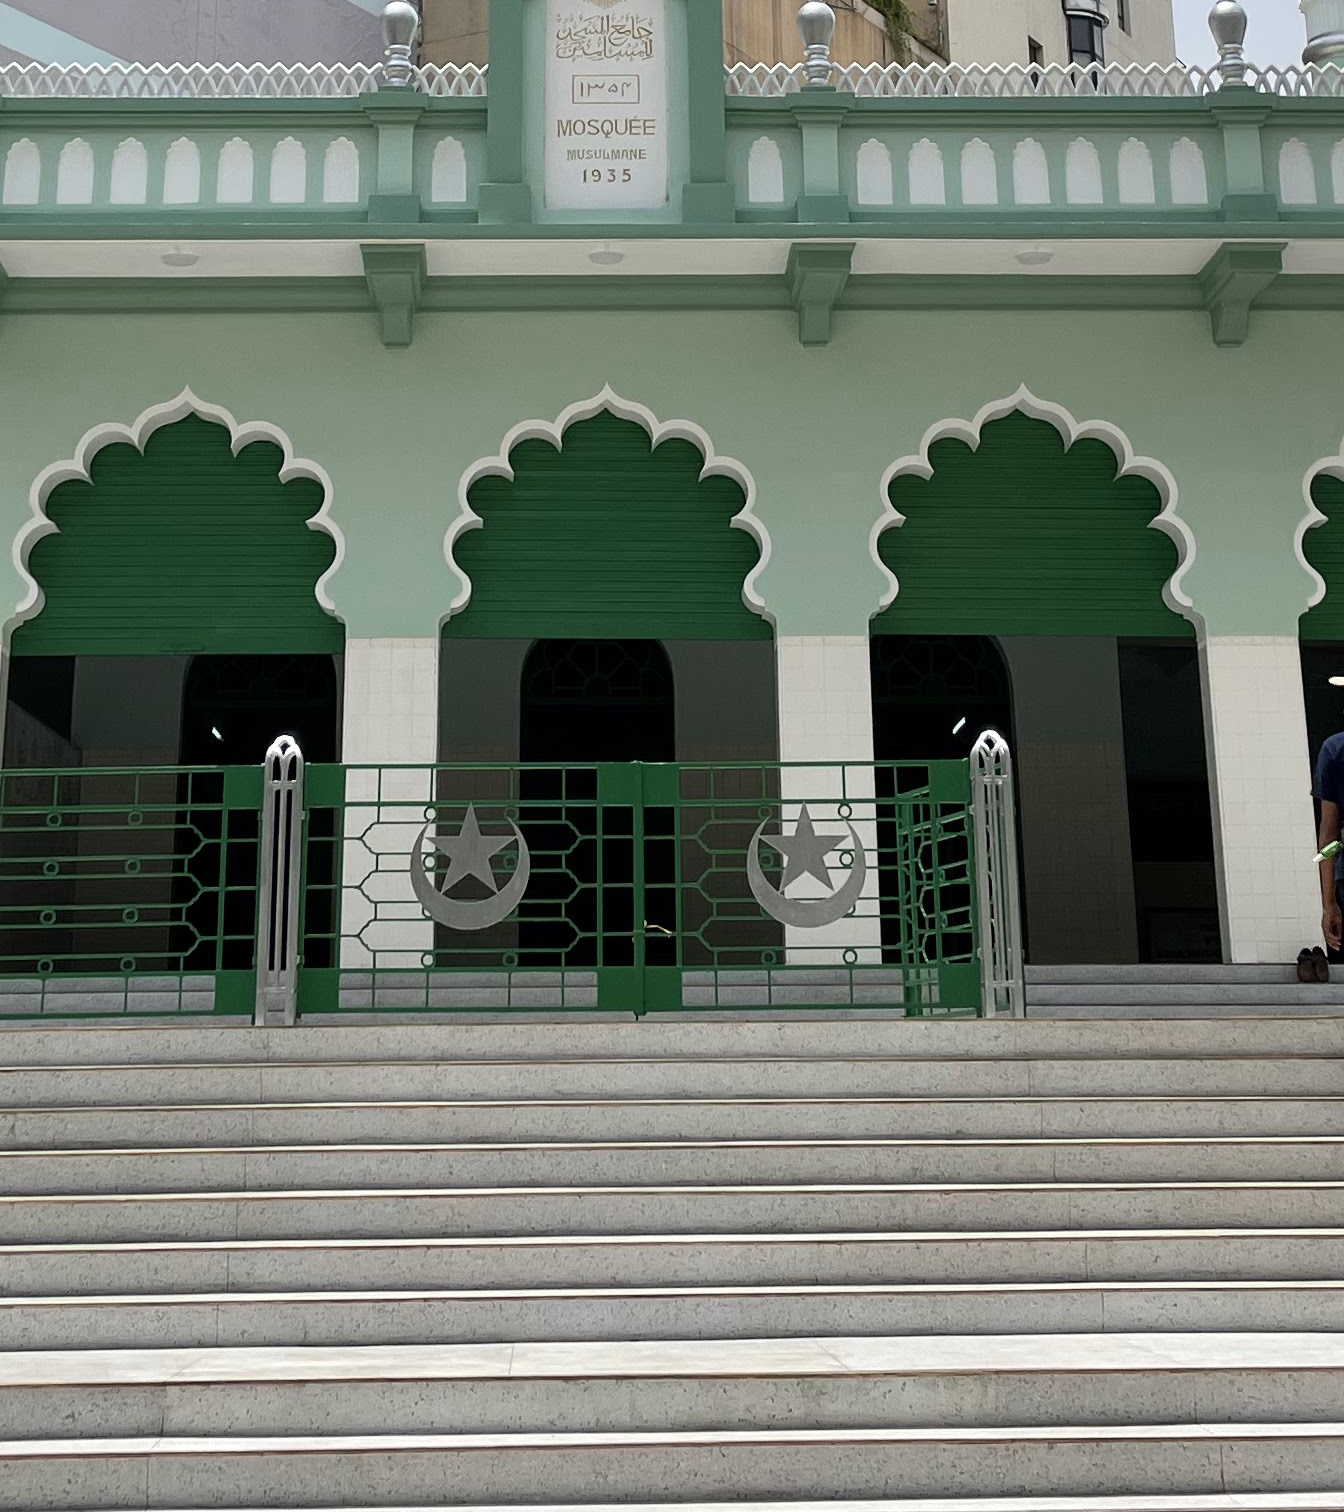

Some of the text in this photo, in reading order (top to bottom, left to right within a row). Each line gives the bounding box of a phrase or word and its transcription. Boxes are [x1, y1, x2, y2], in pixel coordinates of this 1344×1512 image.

[556, 115, 656, 139] MOSQUÉE
[566, 148, 647, 161] MUSULMANE
[582, 168, 632, 184] 1935
